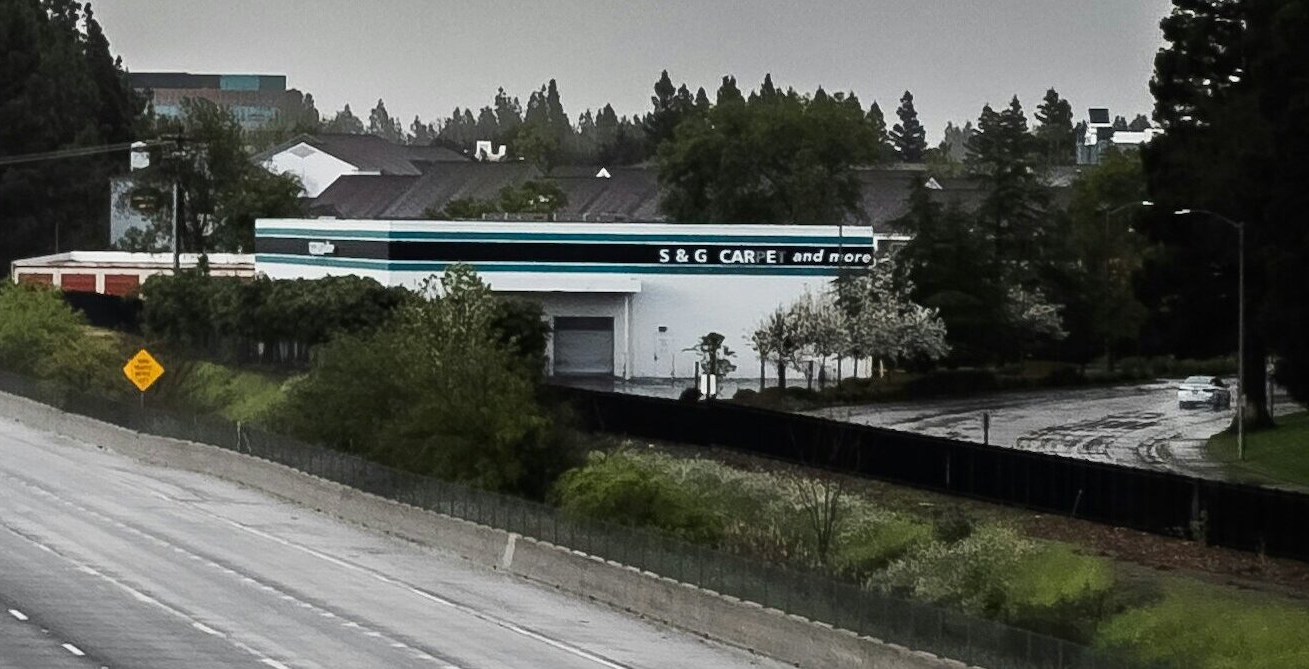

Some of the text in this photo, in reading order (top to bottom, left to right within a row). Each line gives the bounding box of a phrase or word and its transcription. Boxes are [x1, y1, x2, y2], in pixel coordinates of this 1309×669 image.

[659, 248, 872, 264] S & G CARPET and more
